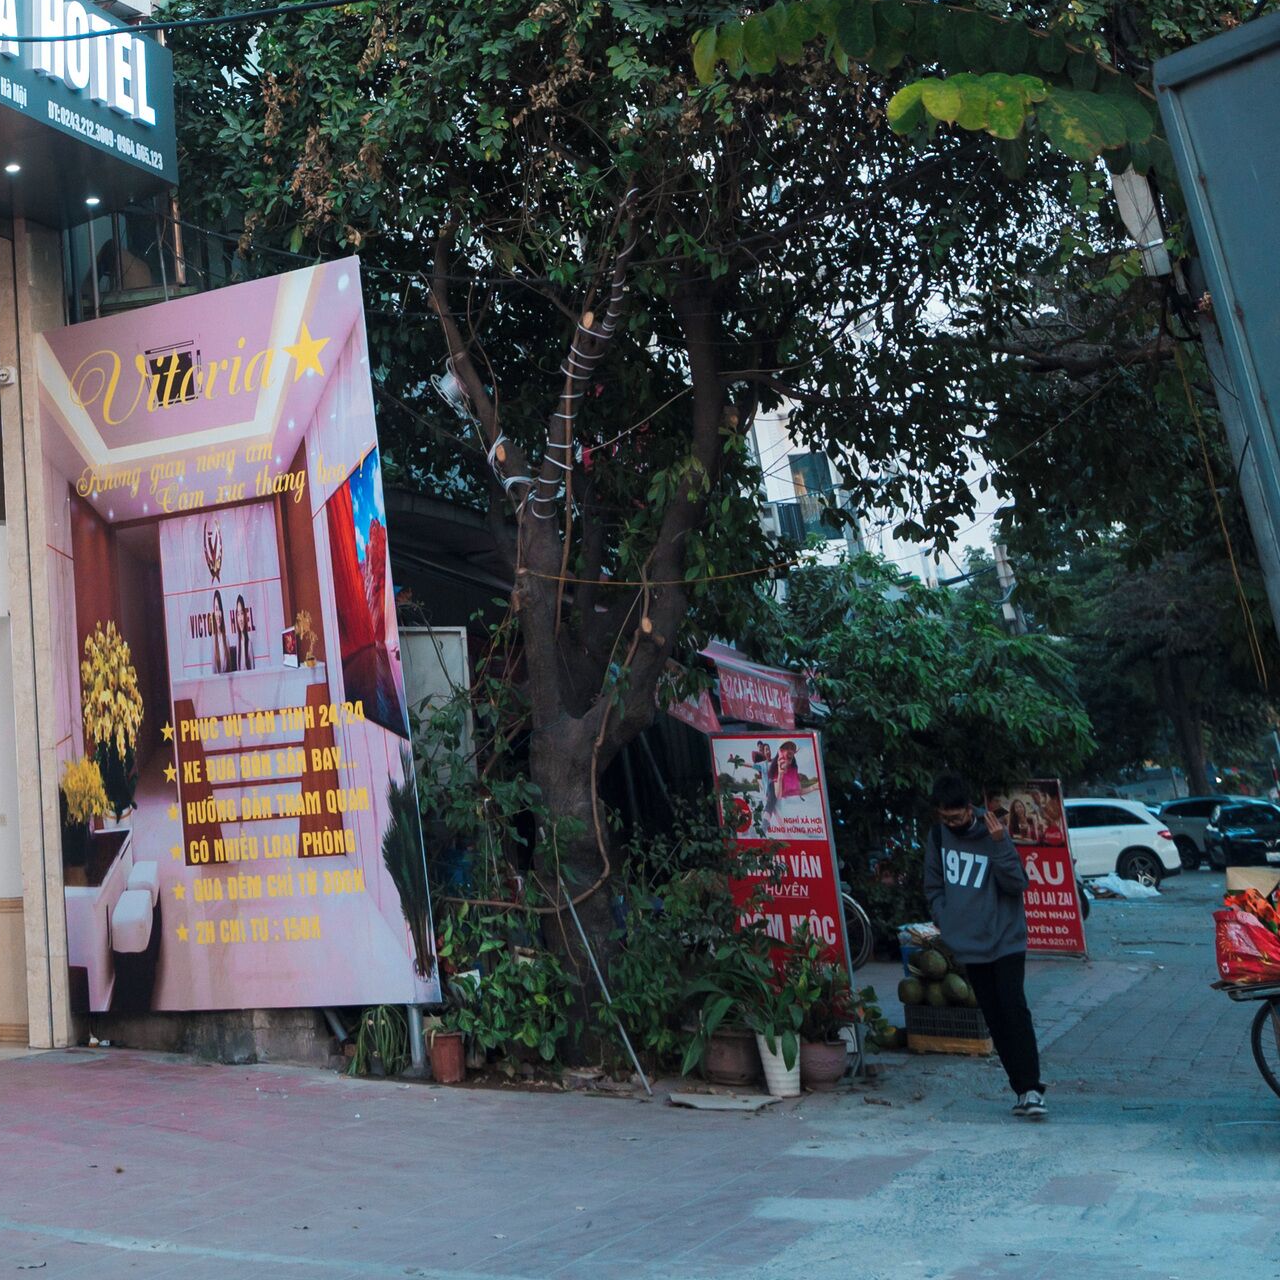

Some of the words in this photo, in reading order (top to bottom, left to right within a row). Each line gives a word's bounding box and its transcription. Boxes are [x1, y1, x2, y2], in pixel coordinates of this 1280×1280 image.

[0, 77, 13, 100] Hà
[13, 82, 28, 109] Nội
[71, 336, 275, 426] Vitoria
[181, 717, 219, 745] PHỤC
[223, 713, 242, 742] VỤ
[279, 705, 315, 731] TÌNH
[319, 700, 365, 728] 24/24
[183, 760, 202, 784] XE
[276, 746, 307, 777] SÂN
[276, 791, 322, 817] THAM
[326, 787, 369, 814] QUAN
[190, 835, 209, 864] CÓ
[302, 826, 356, 856] PHÒNG
[790, 850, 822, 878] VÂN
[193, 877, 223, 902] QUA
[763, 881, 809, 897] HUYÊN
[1042, 892, 1056, 906] LAI
[1058, 892, 1073, 906] ZAI
[195, 920, 216, 944] 2H
